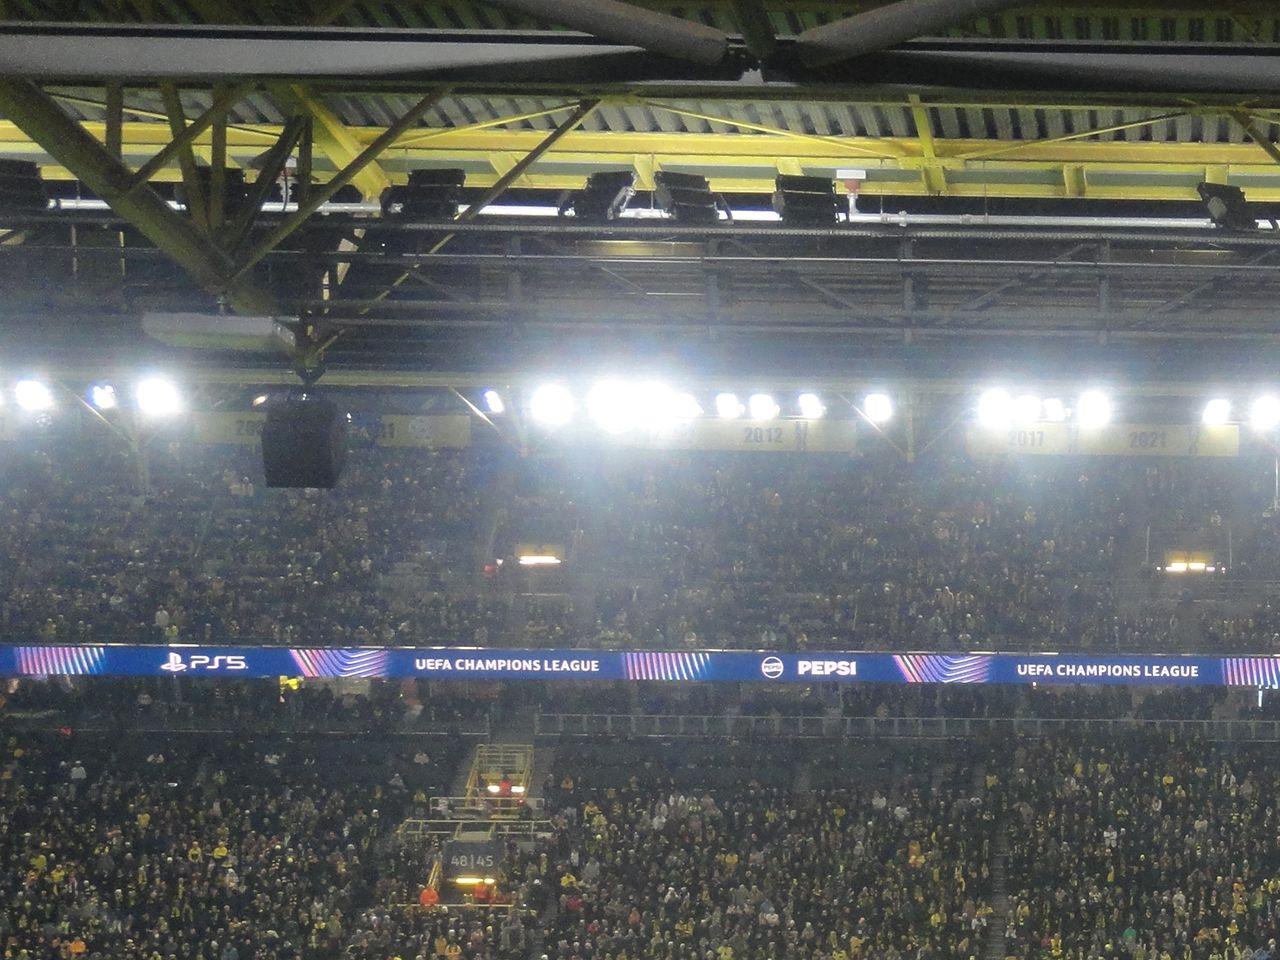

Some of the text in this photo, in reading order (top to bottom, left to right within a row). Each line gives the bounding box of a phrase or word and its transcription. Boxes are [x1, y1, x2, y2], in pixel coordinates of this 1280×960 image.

[744, 427, 783, 443] 2012
[191, 656, 248, 669] PS5
[416, 658, 600, 672] UEFA CHAMPIONS LEAGUE
[798, 660, 857, 676] PEPSI
[1017, 664, 1199, 677] UEFA CHAMPIONS LEAGUE
